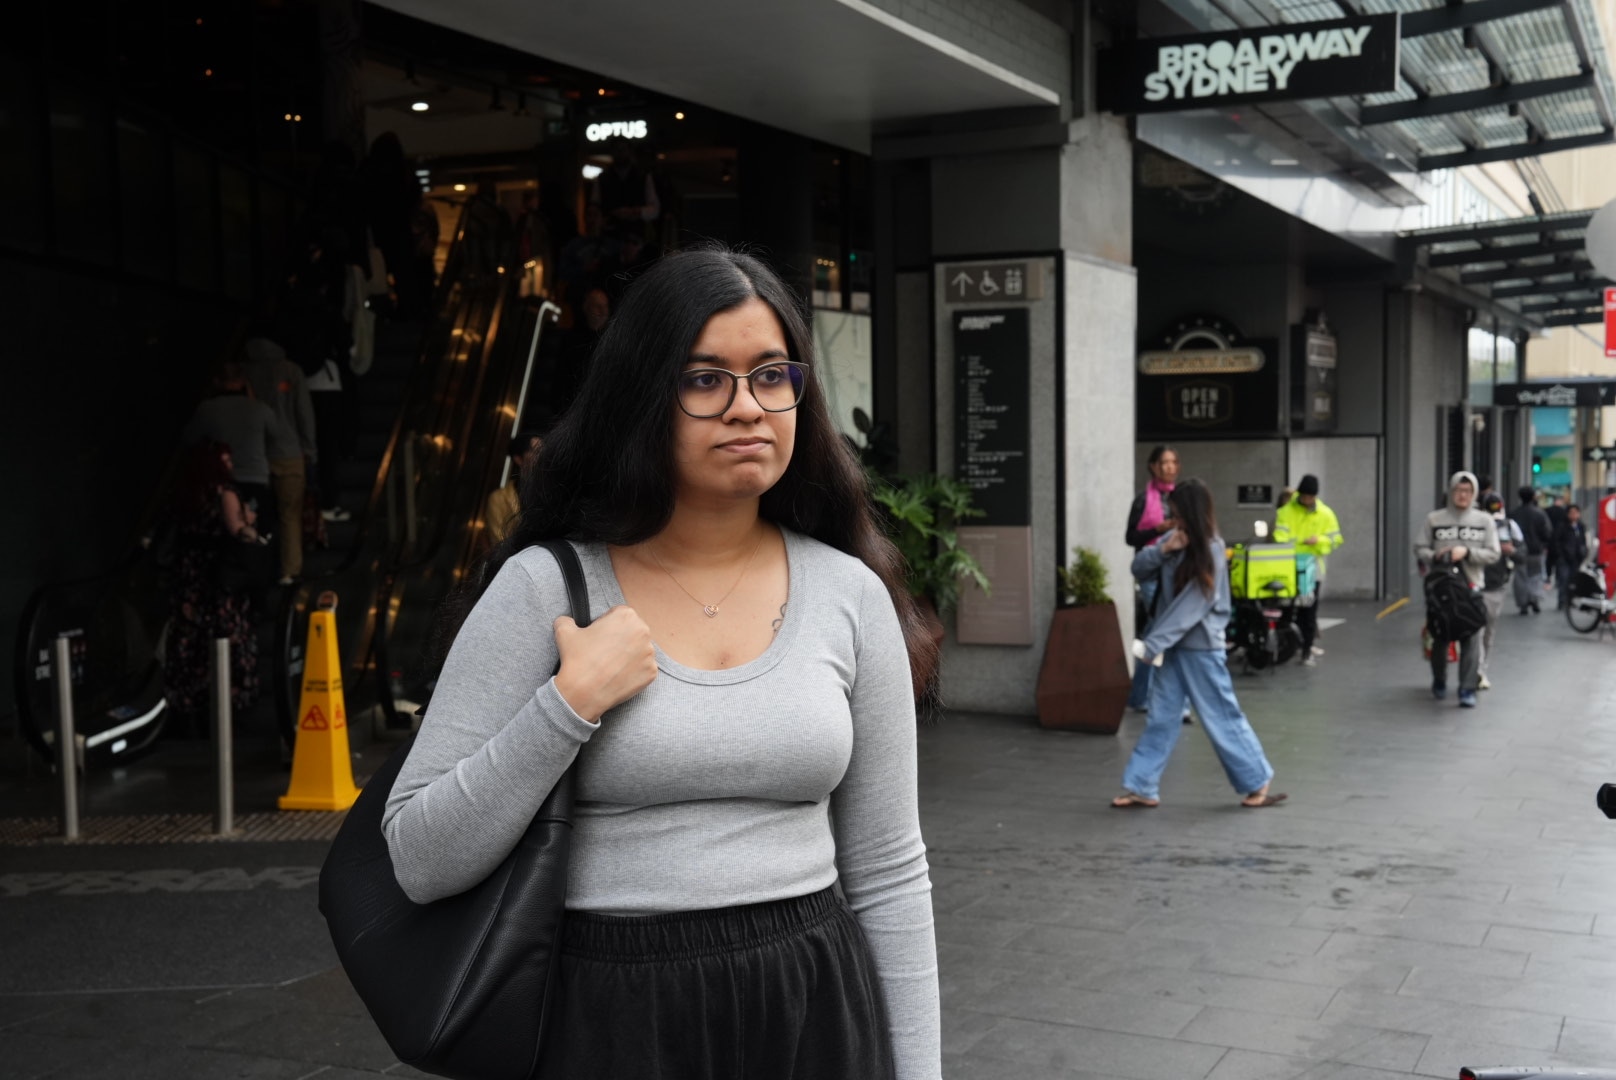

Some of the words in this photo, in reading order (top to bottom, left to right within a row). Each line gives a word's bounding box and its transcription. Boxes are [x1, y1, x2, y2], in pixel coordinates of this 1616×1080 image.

[1158, 26, 1372, 73] BROADWAY
[1144, 60, 1298, 101] SYDNEY
[586, 120, 647, 141] OPTUS
[1181, 387, 1219, 403] OPEN
[1182, 403, 1217, 419] LATE
[1435, 526, 1485, 541] addas
